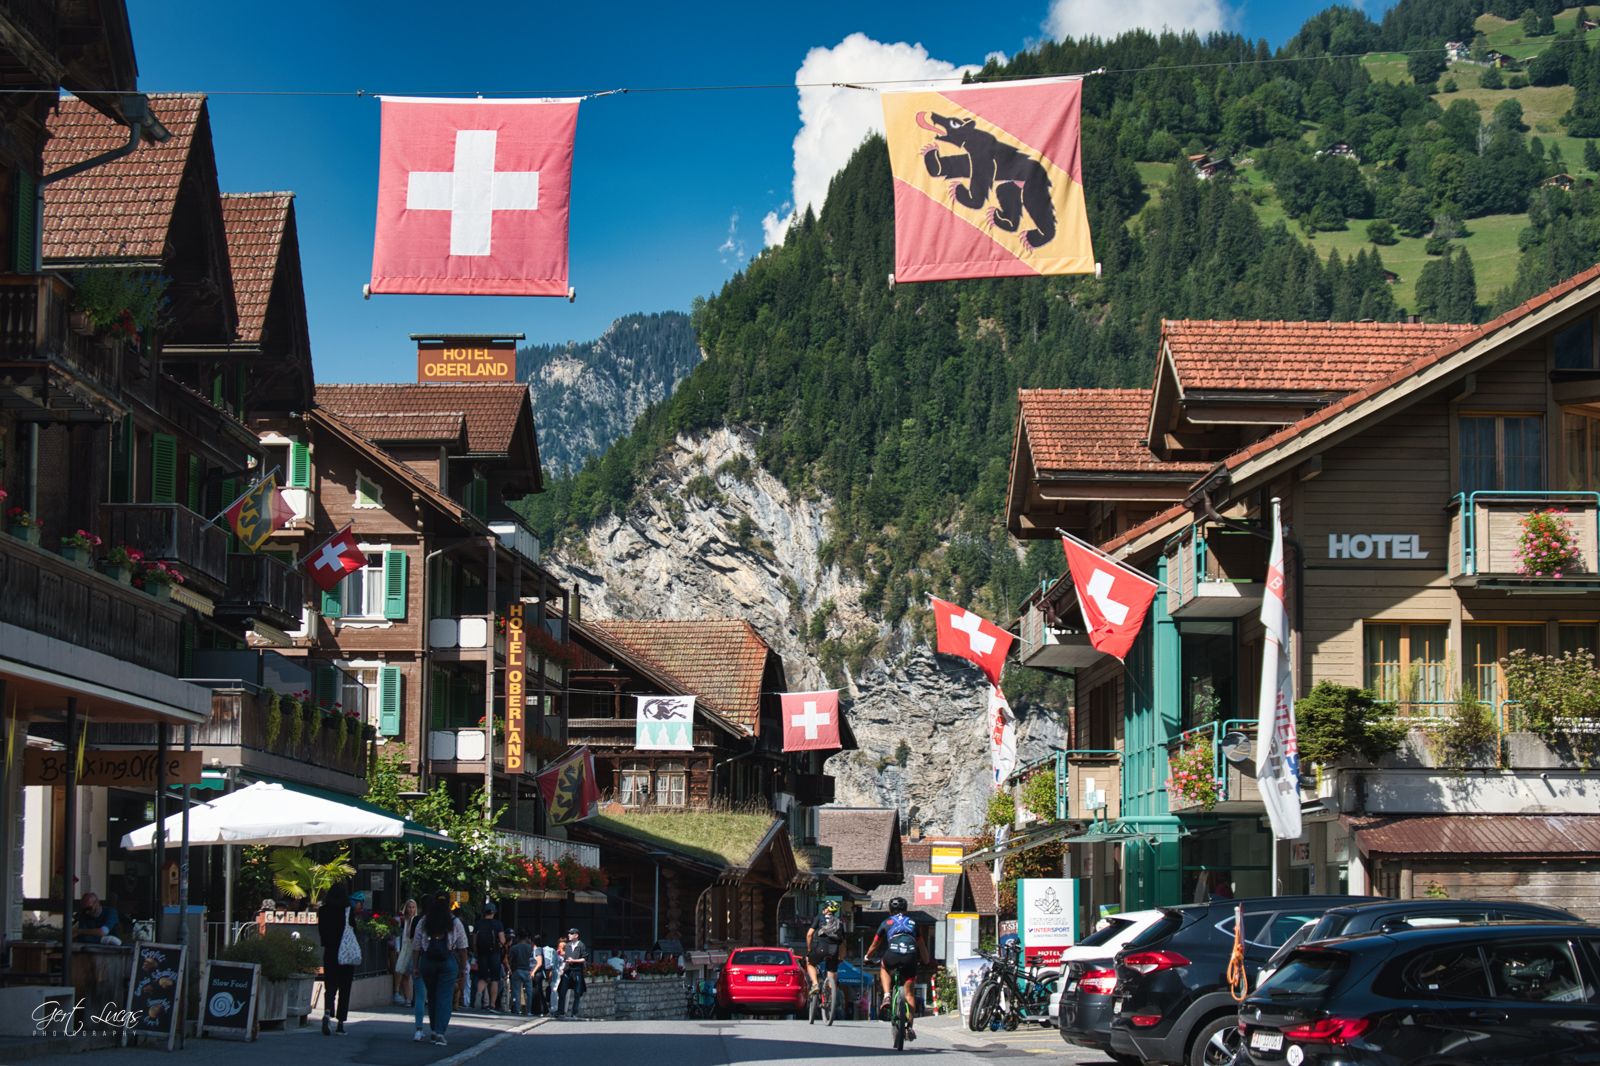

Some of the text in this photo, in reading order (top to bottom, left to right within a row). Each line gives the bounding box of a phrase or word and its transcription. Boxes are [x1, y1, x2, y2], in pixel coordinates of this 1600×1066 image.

[443, 347, 494, 360] HOTEL
[424, 363, 508, 376] OBERLAND
[1328, 533, 1430, 559] HOTEL
[508, 604, 523, 769] HOTEL OBERLAND
[212, 978, 248, 988] Slow Food
